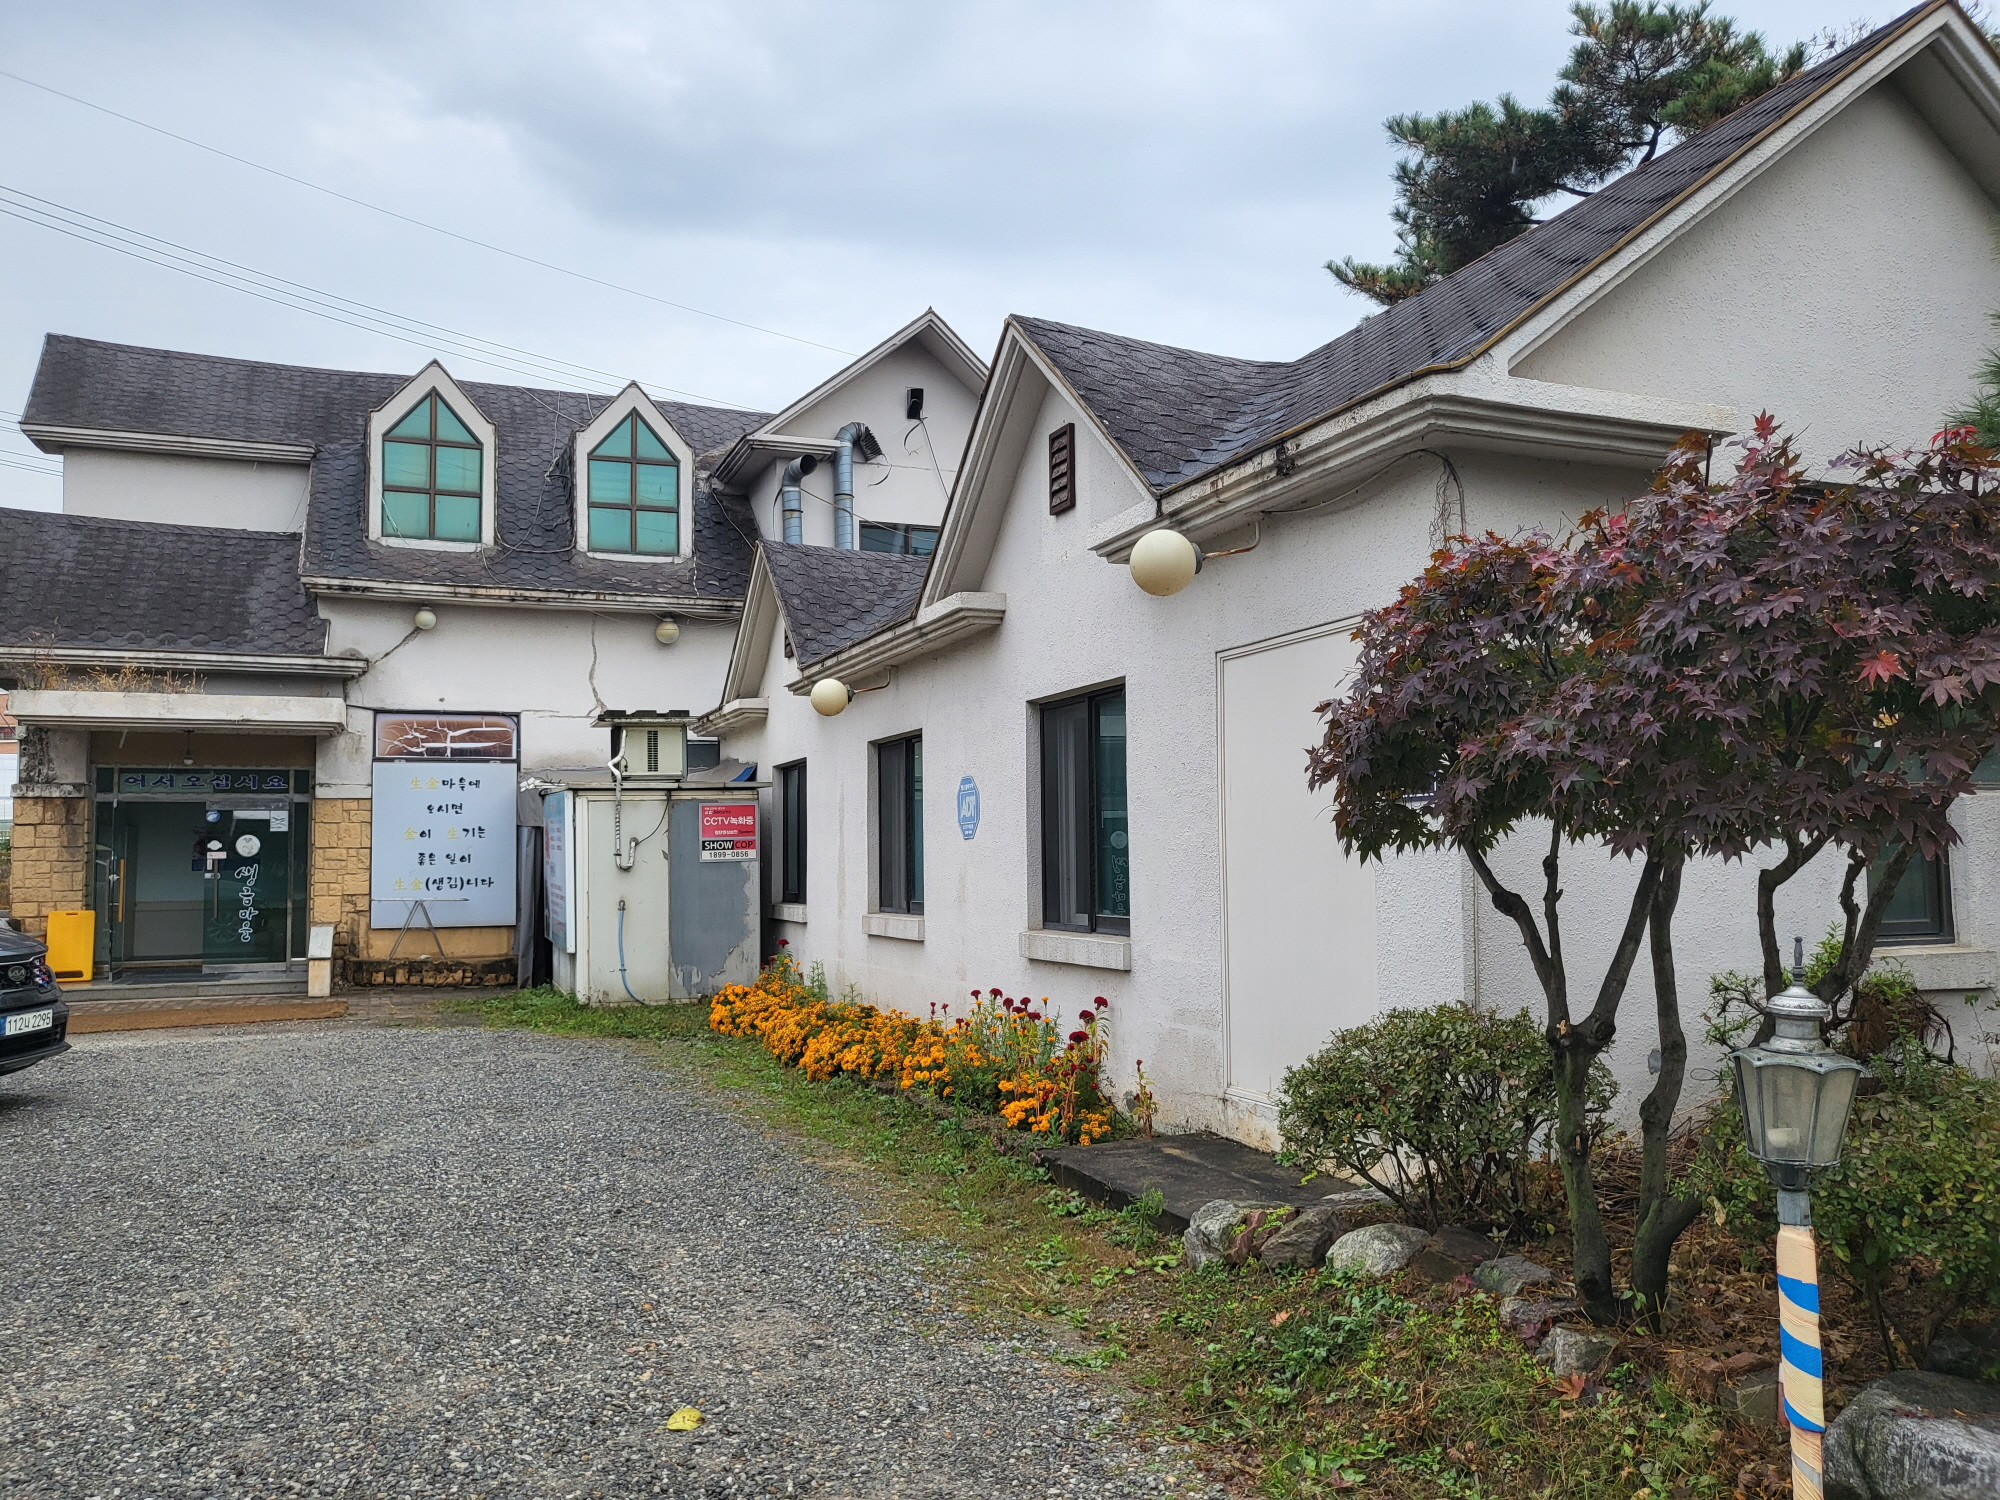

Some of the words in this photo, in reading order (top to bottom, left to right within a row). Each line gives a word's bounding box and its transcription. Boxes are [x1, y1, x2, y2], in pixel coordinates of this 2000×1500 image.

[124, 774, 289, 790] 어서오십시요
[426, 803, 463, 815] 오시면
[960, 796, 976, 818] ADT
[704, 816, 754, 825] CCTV녹화중
[403, 826, 432, 841] 金이
[446, 826, 487, 840] 生기는
[704, 841, 733, 850] SHOW
[418, 852, 437, 867] 좋은
[445, 852, 472, 865] 일이
[235, 864, 259, 943] 생금마을
[32, 1012, 51, 1028] 2295
